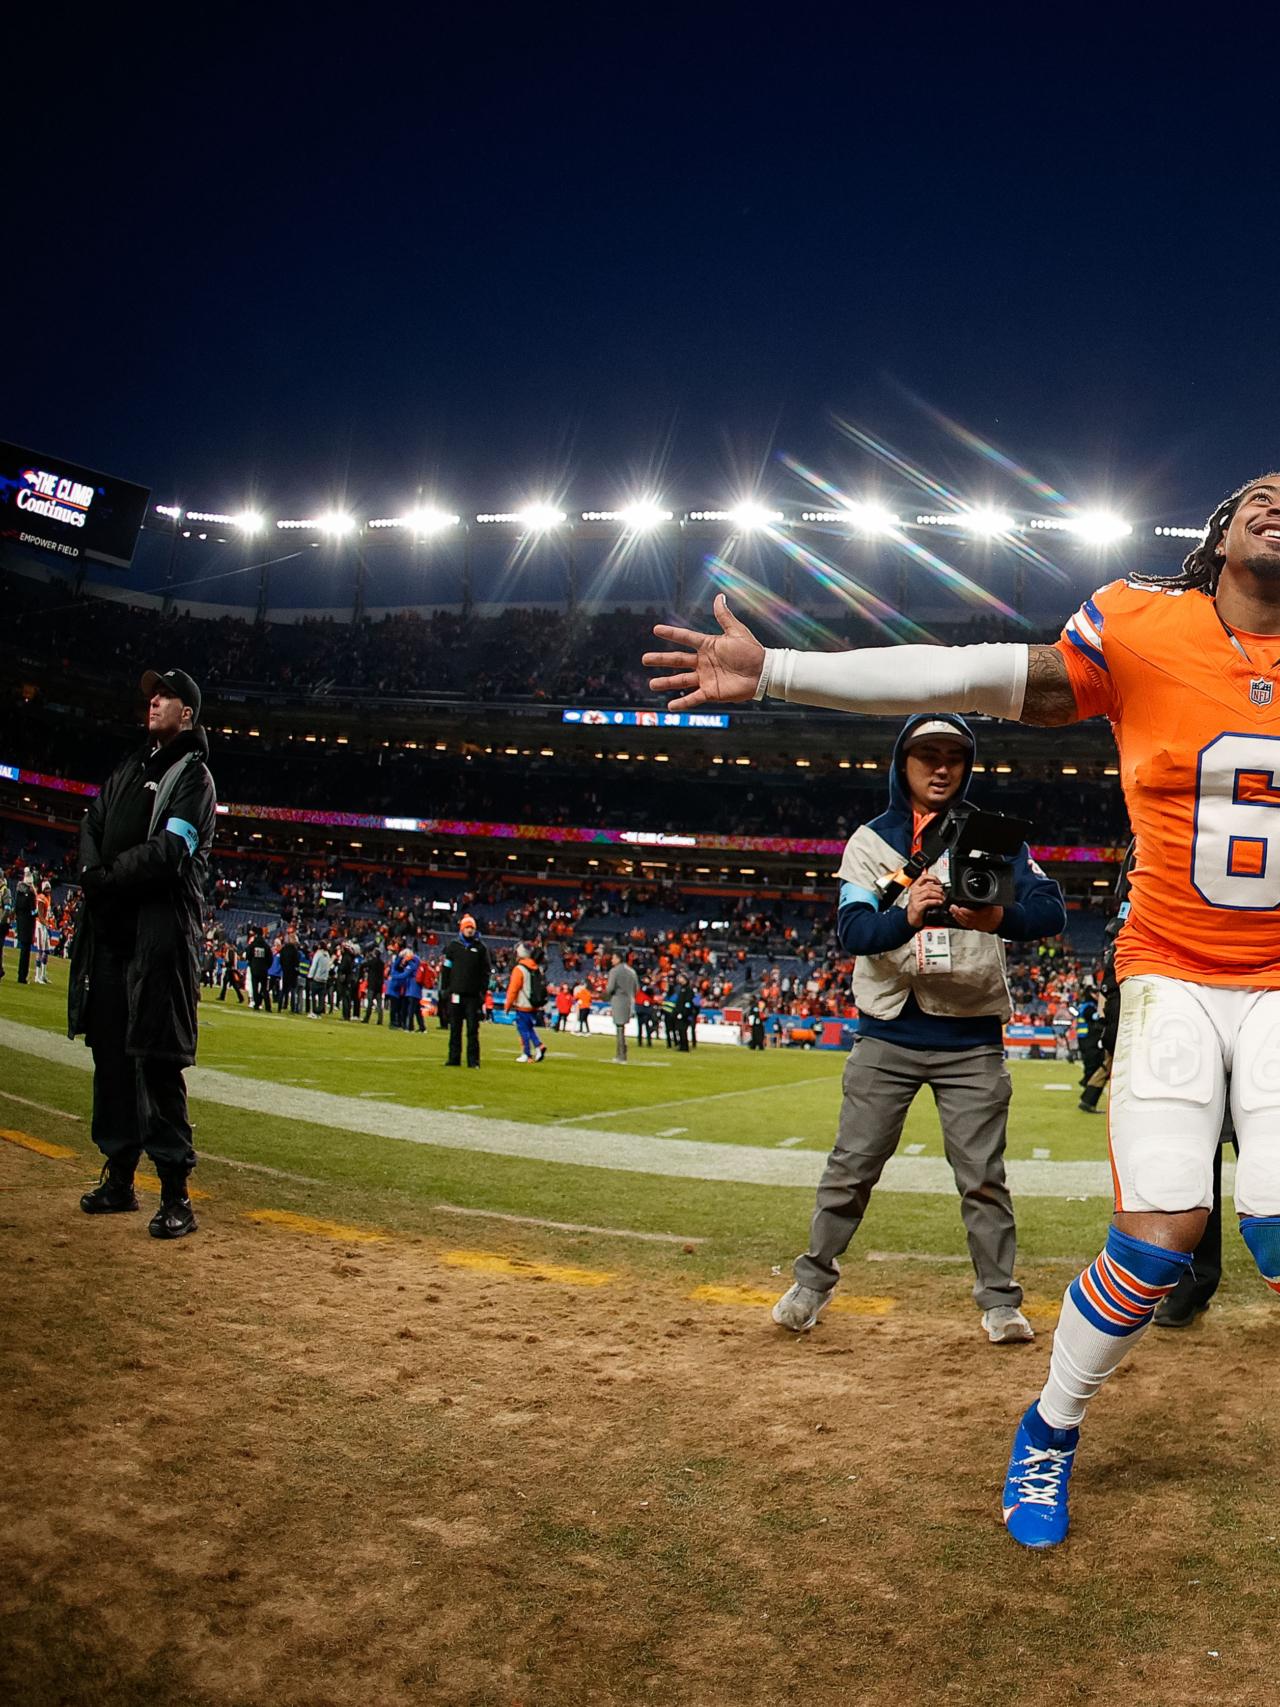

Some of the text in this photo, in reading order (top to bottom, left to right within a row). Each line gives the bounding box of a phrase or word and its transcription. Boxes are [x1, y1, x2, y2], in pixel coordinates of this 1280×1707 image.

[37, 471, 94, 507] THE CLIMB
[17, 489, 86, 528] Continues
[20, 532, 79, 557] EMPOWER FIELD
[1253, 690, 1270, 701] NFL
[614, 712, 624, 724] 0
[688, 715, 724, 728] FINAL
